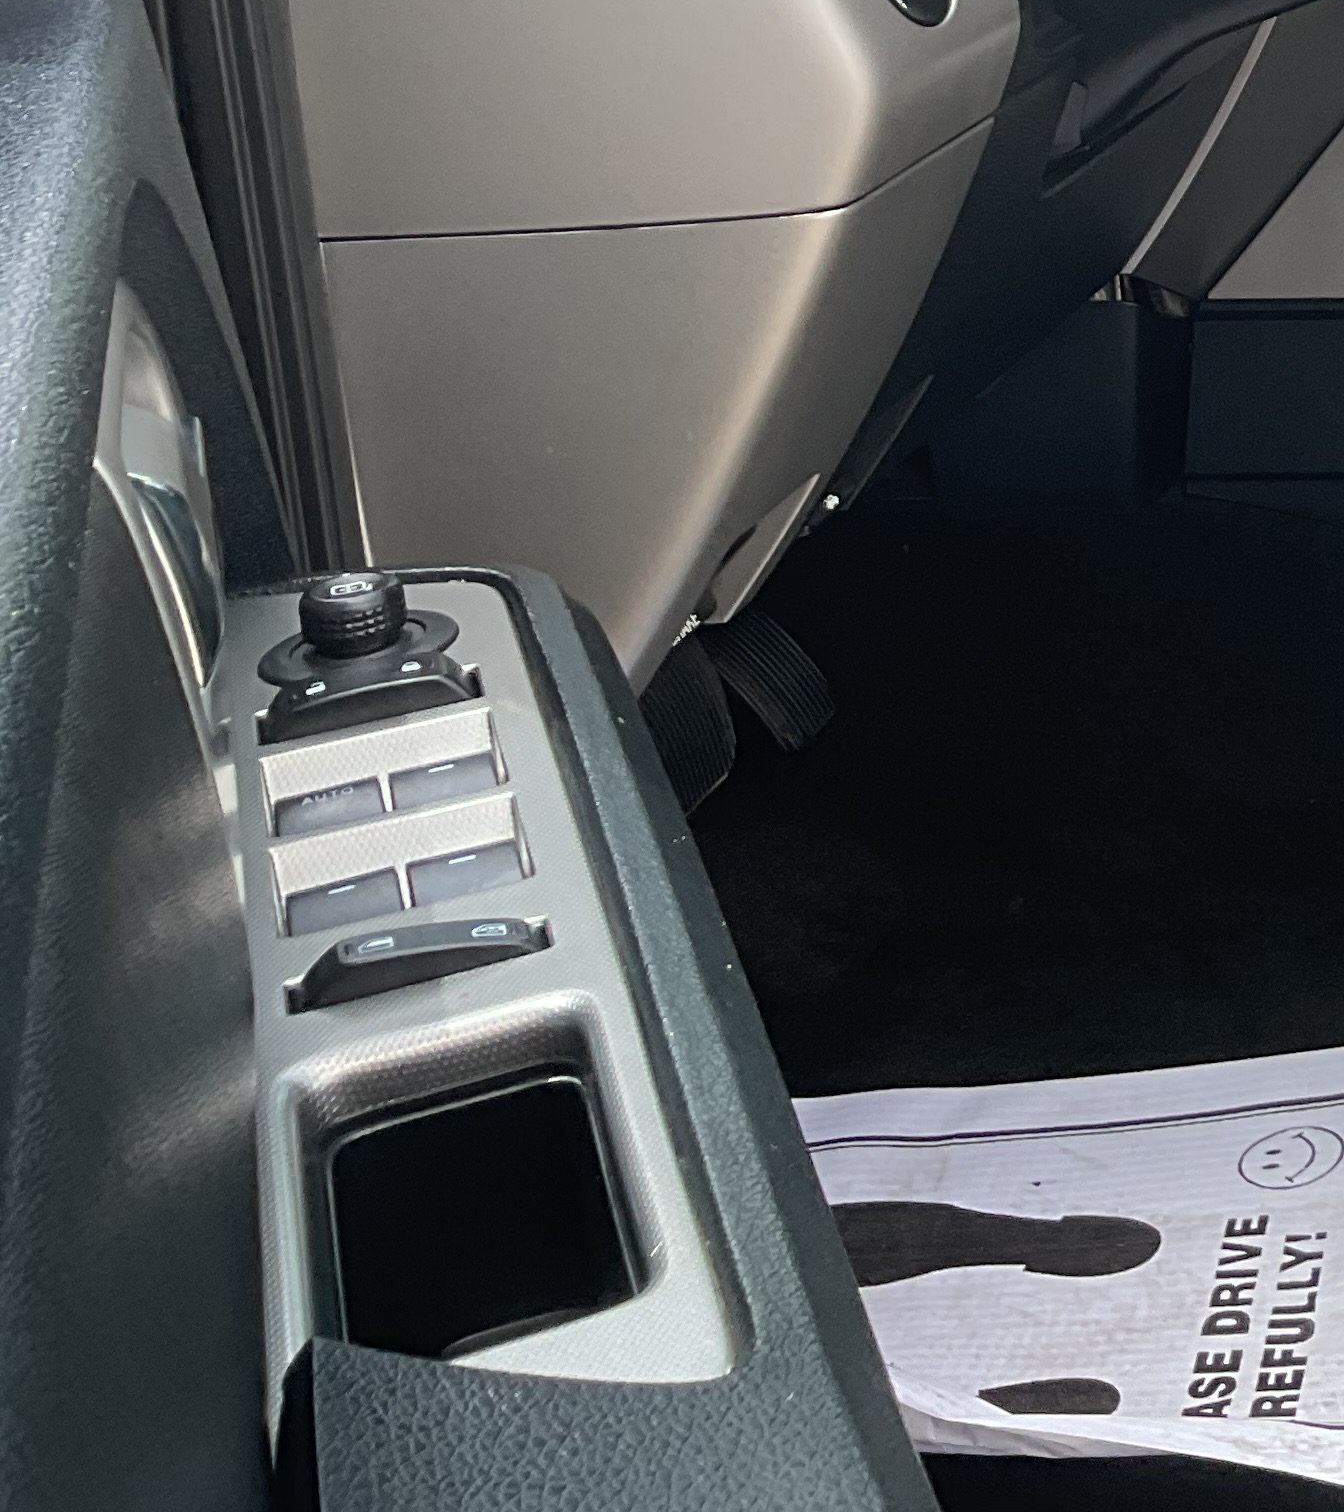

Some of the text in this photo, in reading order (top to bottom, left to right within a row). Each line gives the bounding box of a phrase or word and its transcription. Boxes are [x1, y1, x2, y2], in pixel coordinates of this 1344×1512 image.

[301, 786, 354, 806] AUTO
[1181, 1214, 1270, 1418] ASE DRIVE
[1249, 1231, 1328, 1418] REFULLY!
